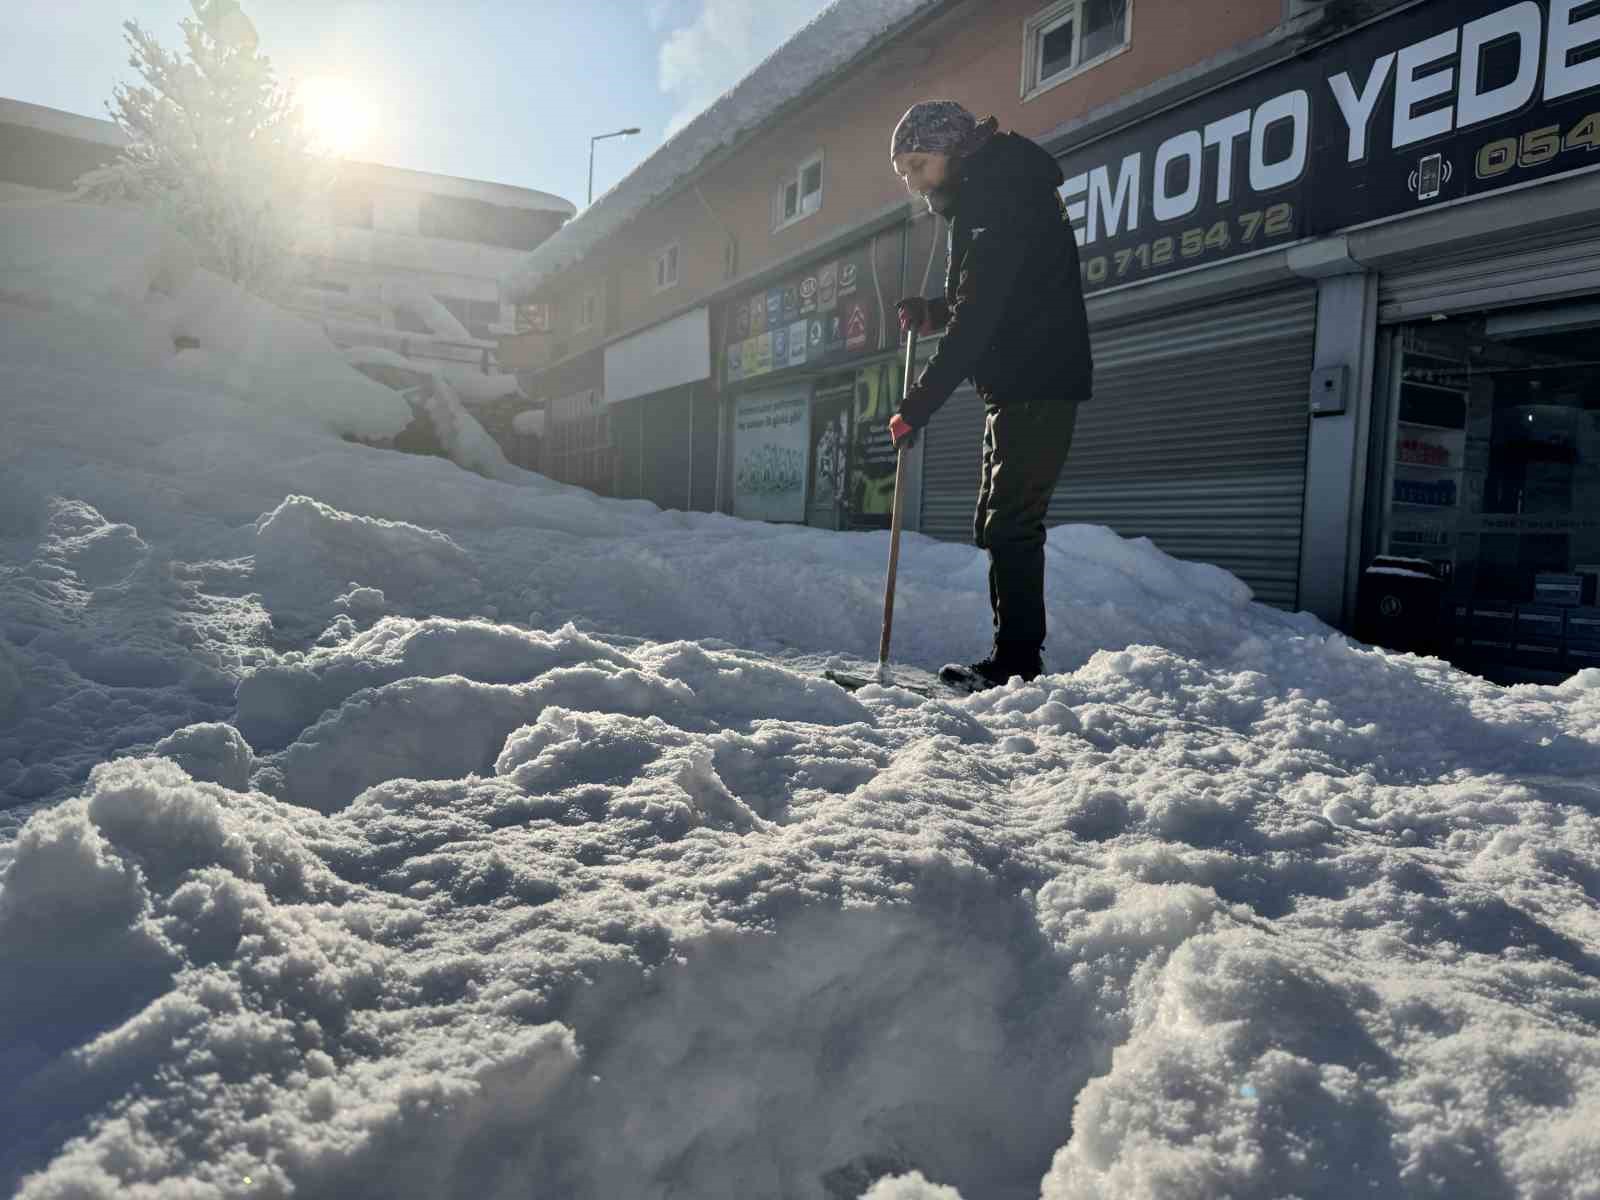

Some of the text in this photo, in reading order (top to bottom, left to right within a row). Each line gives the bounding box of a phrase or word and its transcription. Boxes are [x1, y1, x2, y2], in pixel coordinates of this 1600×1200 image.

[1153, 89, 1309, 221] OTO
[1114, 237, 1174, 277] 712
[1180, 220, 1231, 257] 54
[1239, 203, 1294, 242] 72
